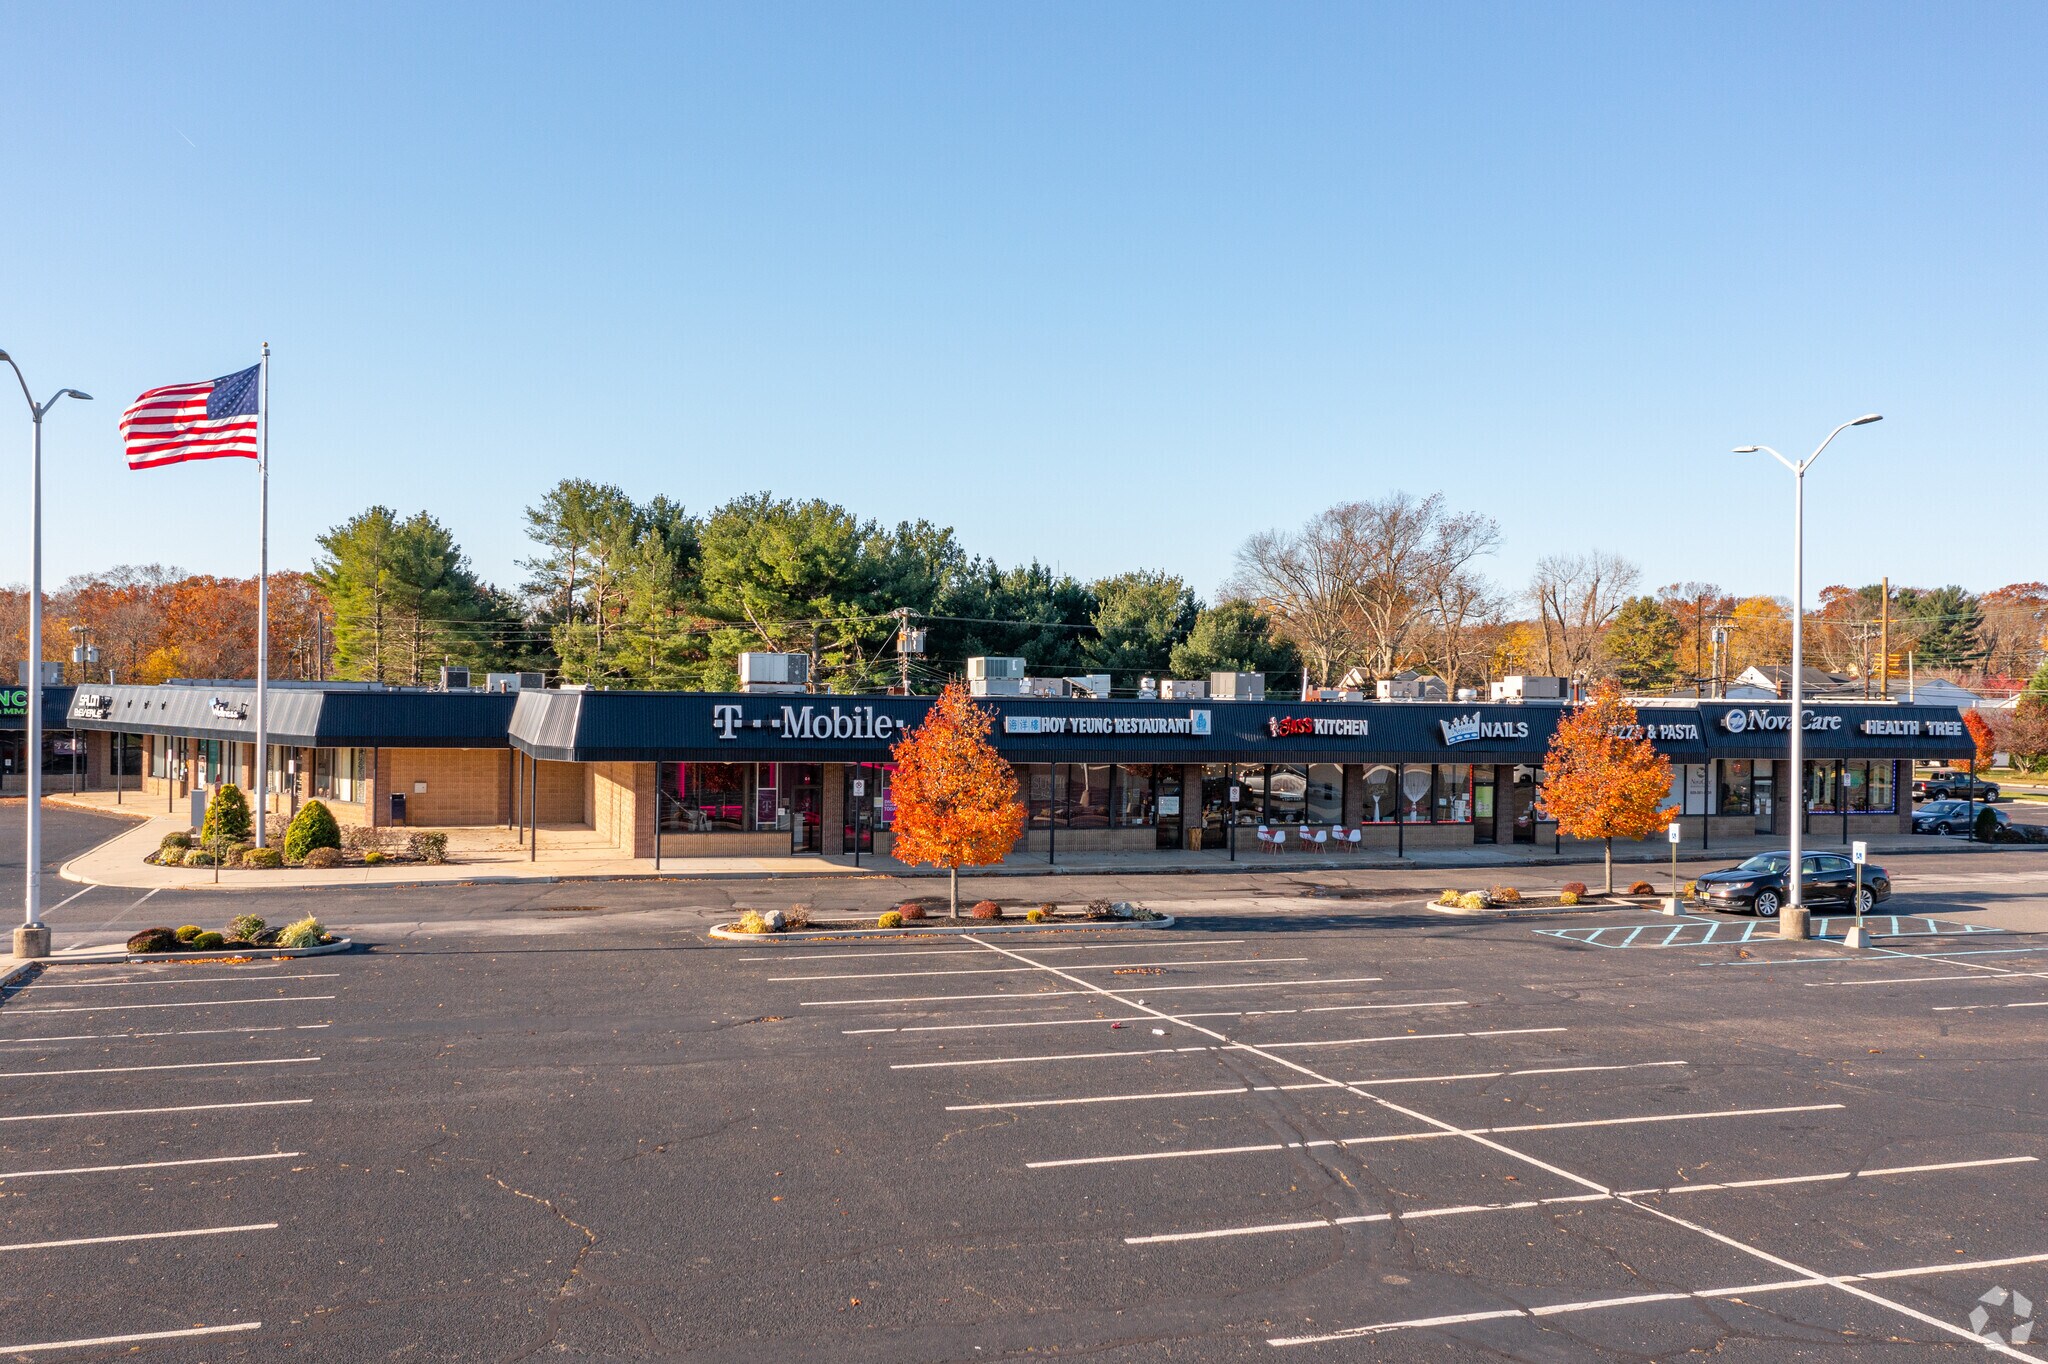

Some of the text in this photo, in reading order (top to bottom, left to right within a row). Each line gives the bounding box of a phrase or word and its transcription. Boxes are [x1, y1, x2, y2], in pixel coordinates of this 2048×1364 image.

[1041, 717, 1192, 734] HOY YEUNG RESTAURANT
[1313, 719, 1368, 735] KITCHEN
[1481, 722, 1529, 738] NAILS
[1647, 724, 1657, 739] &
[1660, 724, 1699, 739] PASTA
[1866, 720, 1962, 736] HEALTH TREE
